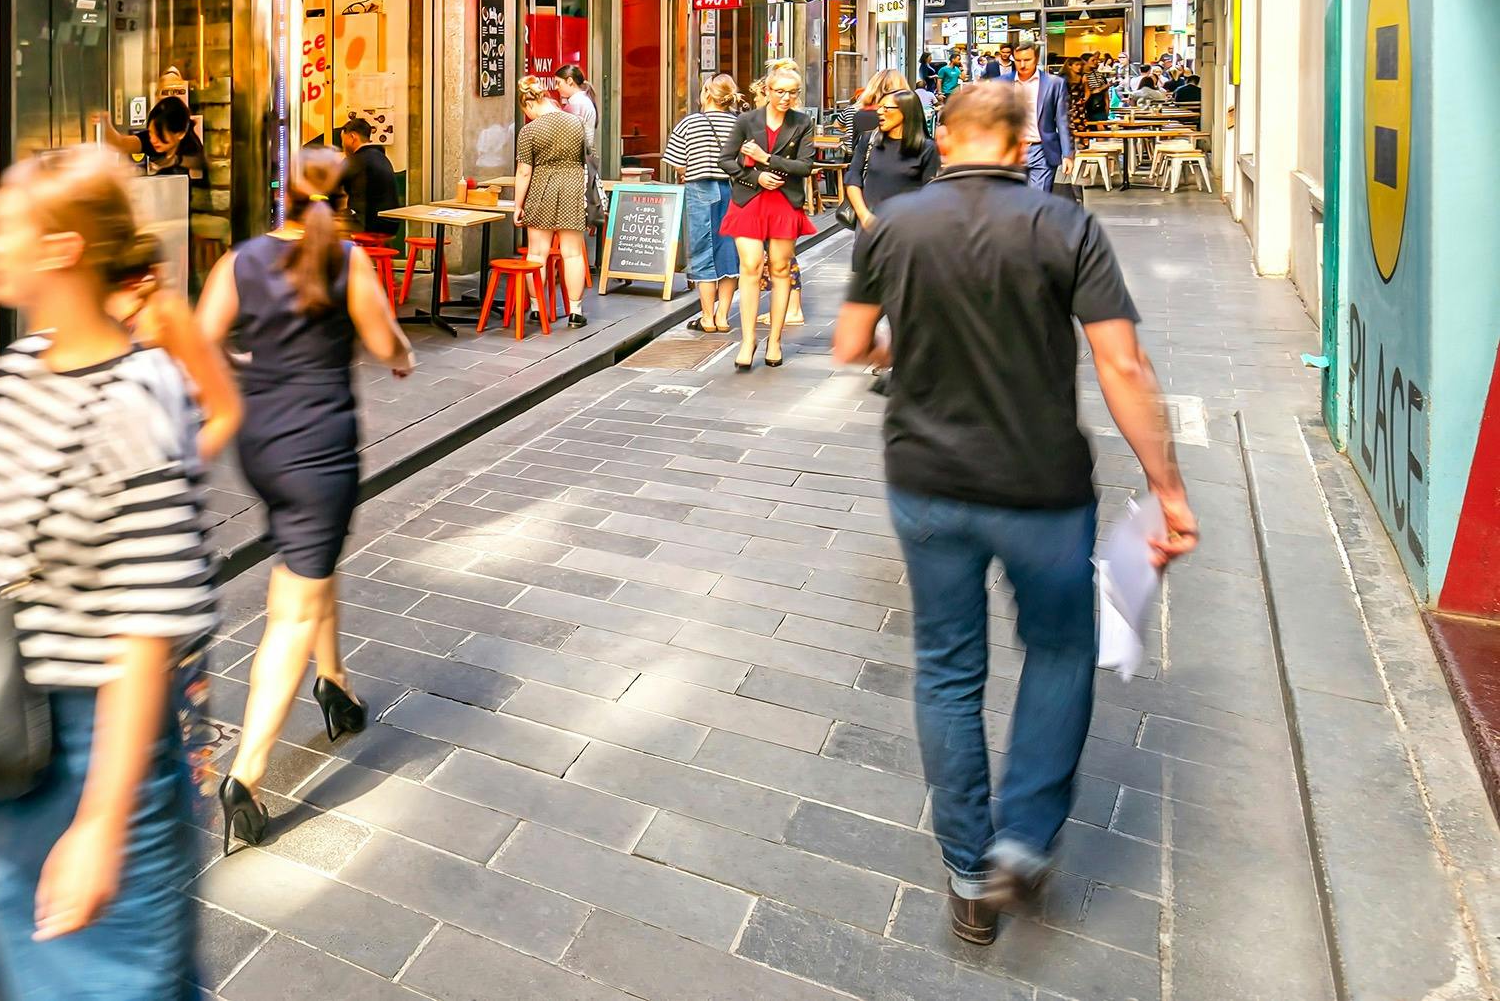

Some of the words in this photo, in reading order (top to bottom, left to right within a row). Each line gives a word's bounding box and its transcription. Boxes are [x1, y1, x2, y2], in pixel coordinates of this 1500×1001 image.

[627, 213, 659, 225] MEAT
[621, 223, 660, 236] LOVER
[1348, 301, 1425, 569] PLACE
